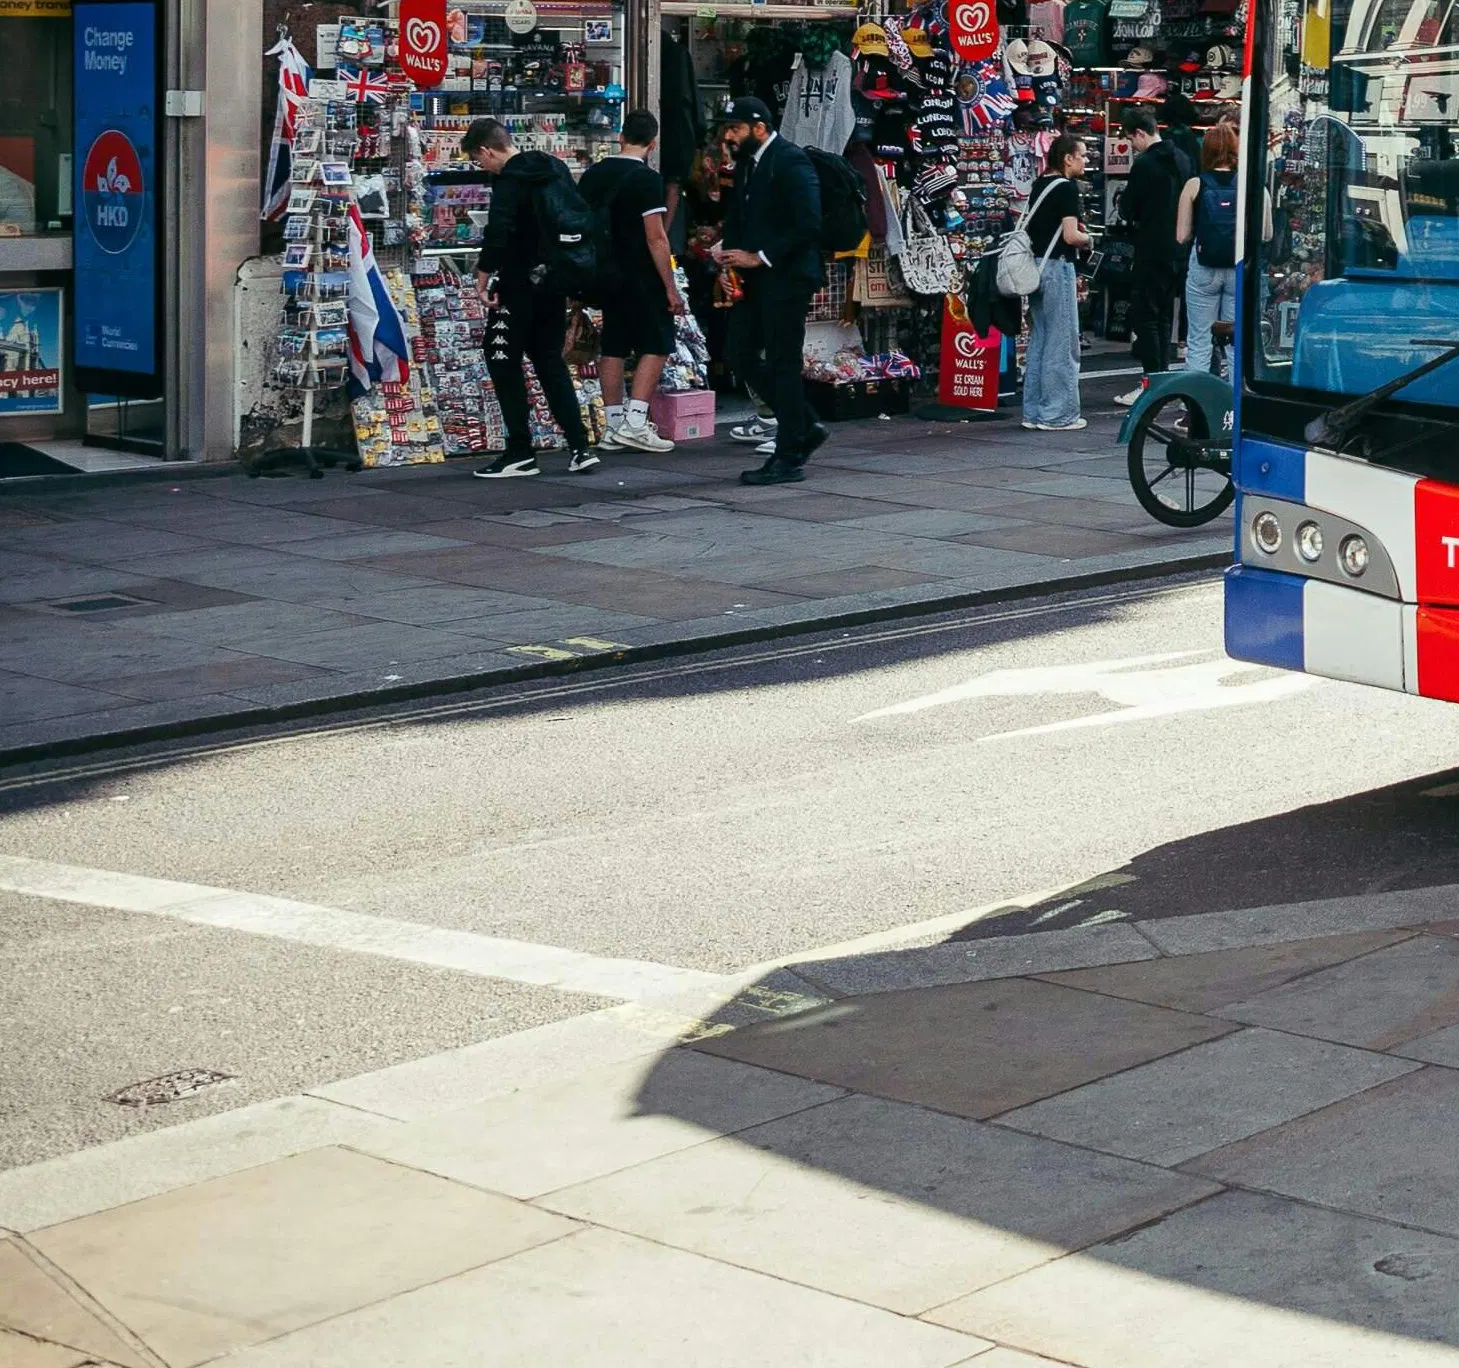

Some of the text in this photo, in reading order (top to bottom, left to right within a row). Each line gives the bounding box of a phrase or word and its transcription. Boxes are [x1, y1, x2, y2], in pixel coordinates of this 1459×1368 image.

[84, 27, 134, 51] Change
[958, 32, 993, 47] WALL'S
[84, 50, 127, 75] Money
[405, 53, 440, 72] WALL'S
[97, 205, 128, 227] HKD
[955, 358, 984, 370] WALL'S
[23, 373, 57, 385] here!
[955, 374, 984, 385] ICE CREAM
[953, 386, 983, 397] SOLD HERE
